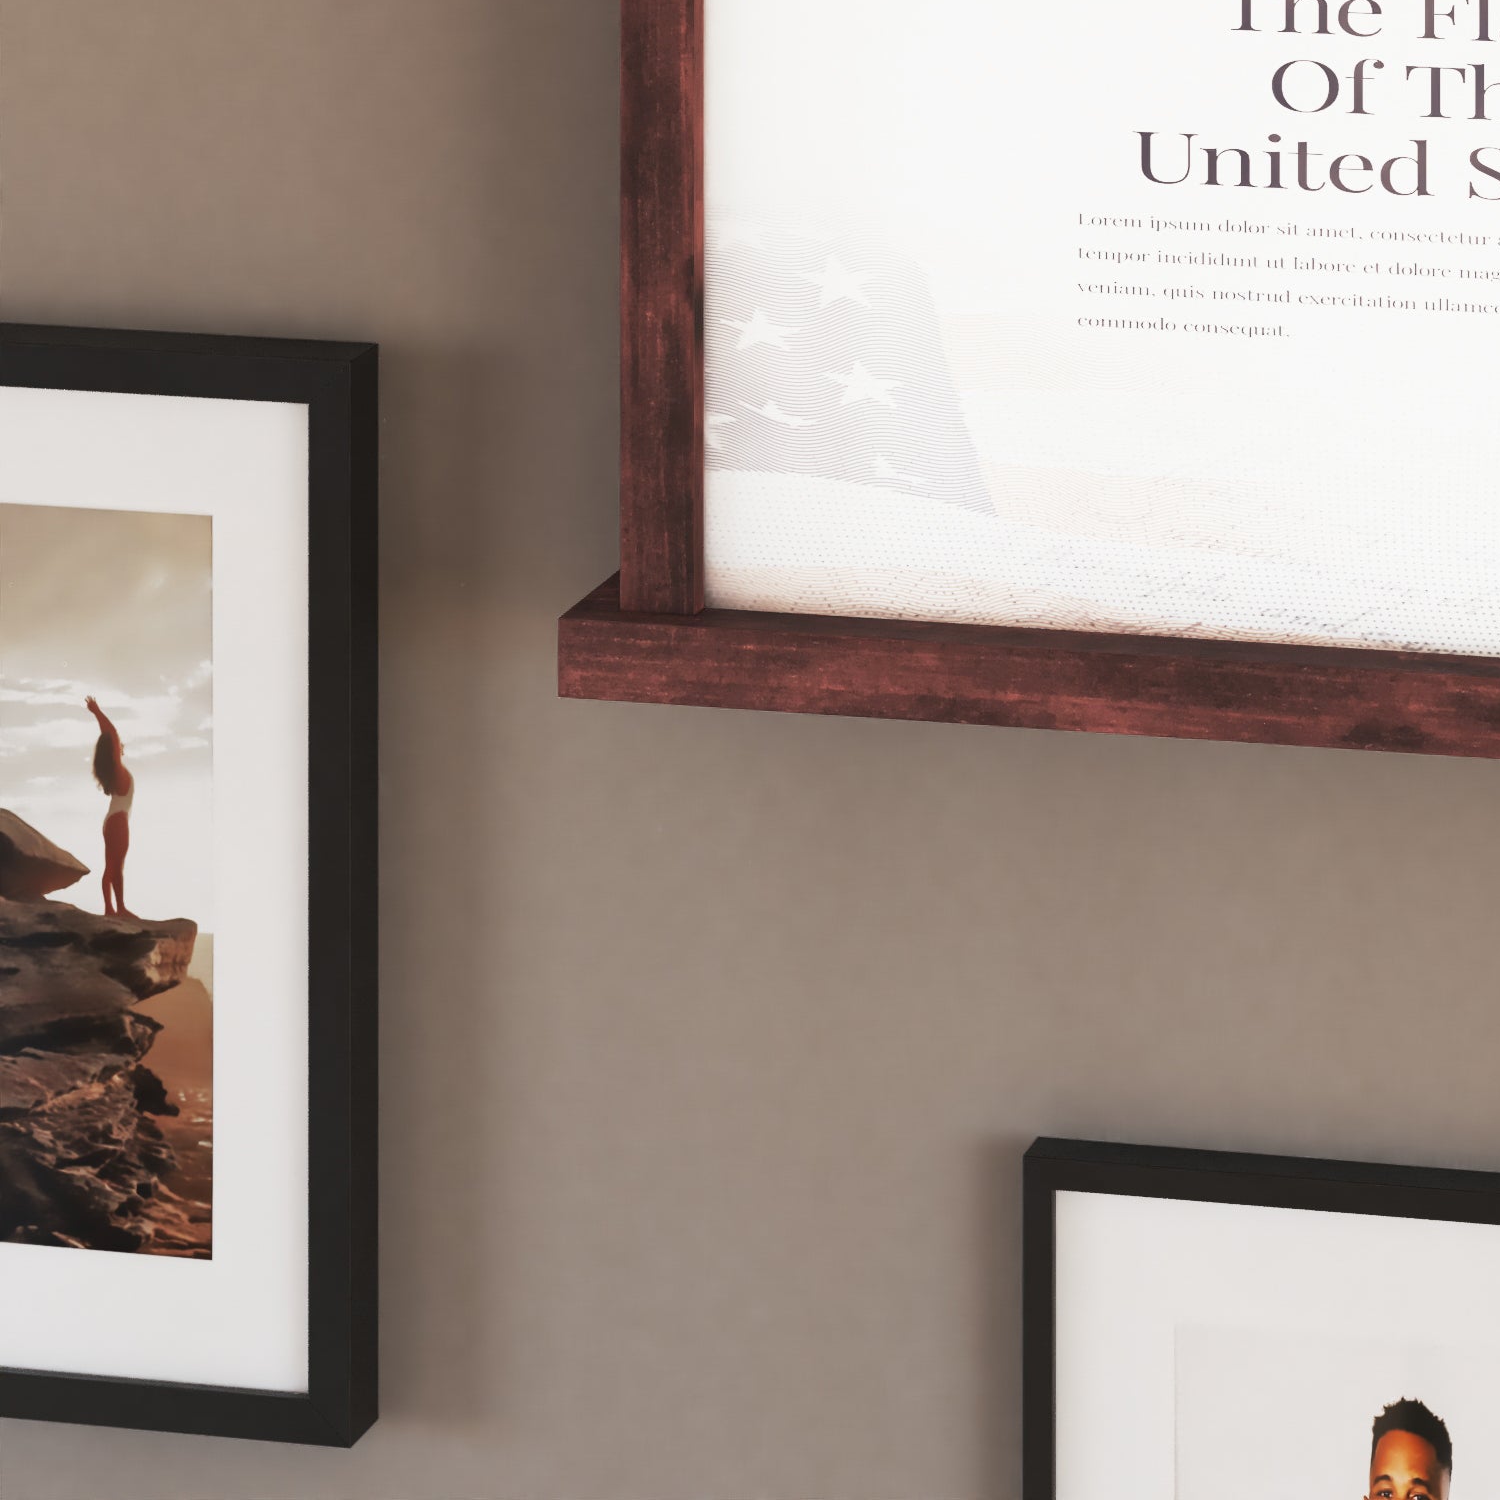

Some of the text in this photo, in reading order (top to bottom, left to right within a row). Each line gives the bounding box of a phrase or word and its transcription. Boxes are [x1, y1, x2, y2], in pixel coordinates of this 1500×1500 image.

[1271, 58, 1385, 116] Of
[1133, 130, 1436, 197] United
[1078, 211, 1144, 229] Lorem
[1149, 215, 1211, 235] ipsum
[1217, 219, 1270, 236] dolor
[1276, 222, 1298, 237] sit
[1368, 227, 1492, 246] consectetur
[1078, 247, 1151, 264] tempor
[1157, 249, 1257, 269] incididunt
[1266, 256, 1286, 270] ut
[1293, 255, 1356, 276] labore
[1362, 262, 1380, 275] et
[1388, 262, 1452, 278] dolore
[1163, 284, 1205, 301] quis
[1212, 289, 1291, 305] nostrud
[1297, 291, 1416, 311] exercitation
[1077, 315, 1291, 338] commodo consequat.
